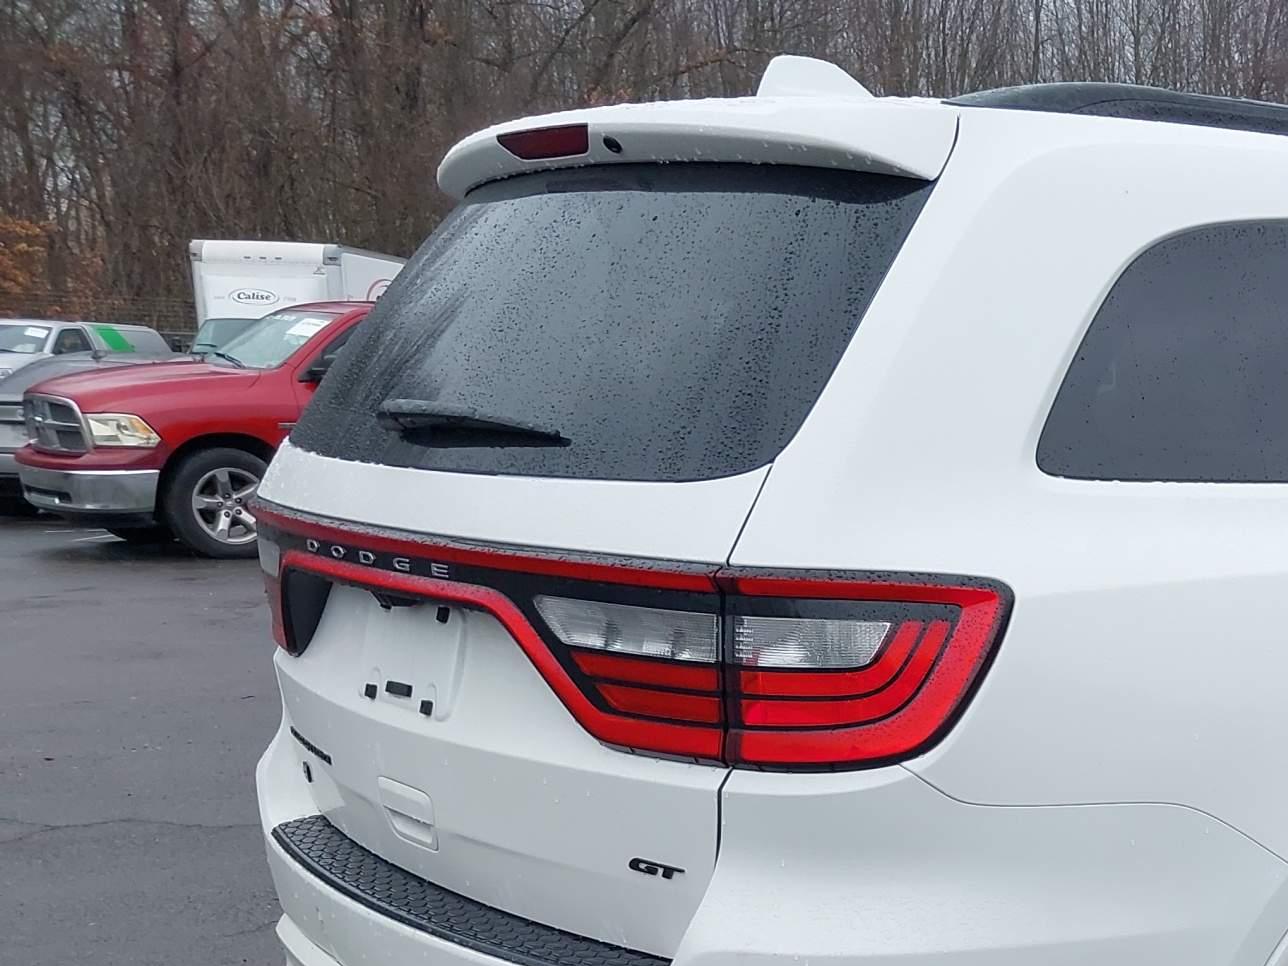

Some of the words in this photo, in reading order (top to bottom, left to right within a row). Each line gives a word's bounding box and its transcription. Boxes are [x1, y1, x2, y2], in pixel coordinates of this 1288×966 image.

[237, 292, 271, 301] Calise
[306, 539, 449, 578] DODGE
[628, 857, 686, 880] GT
